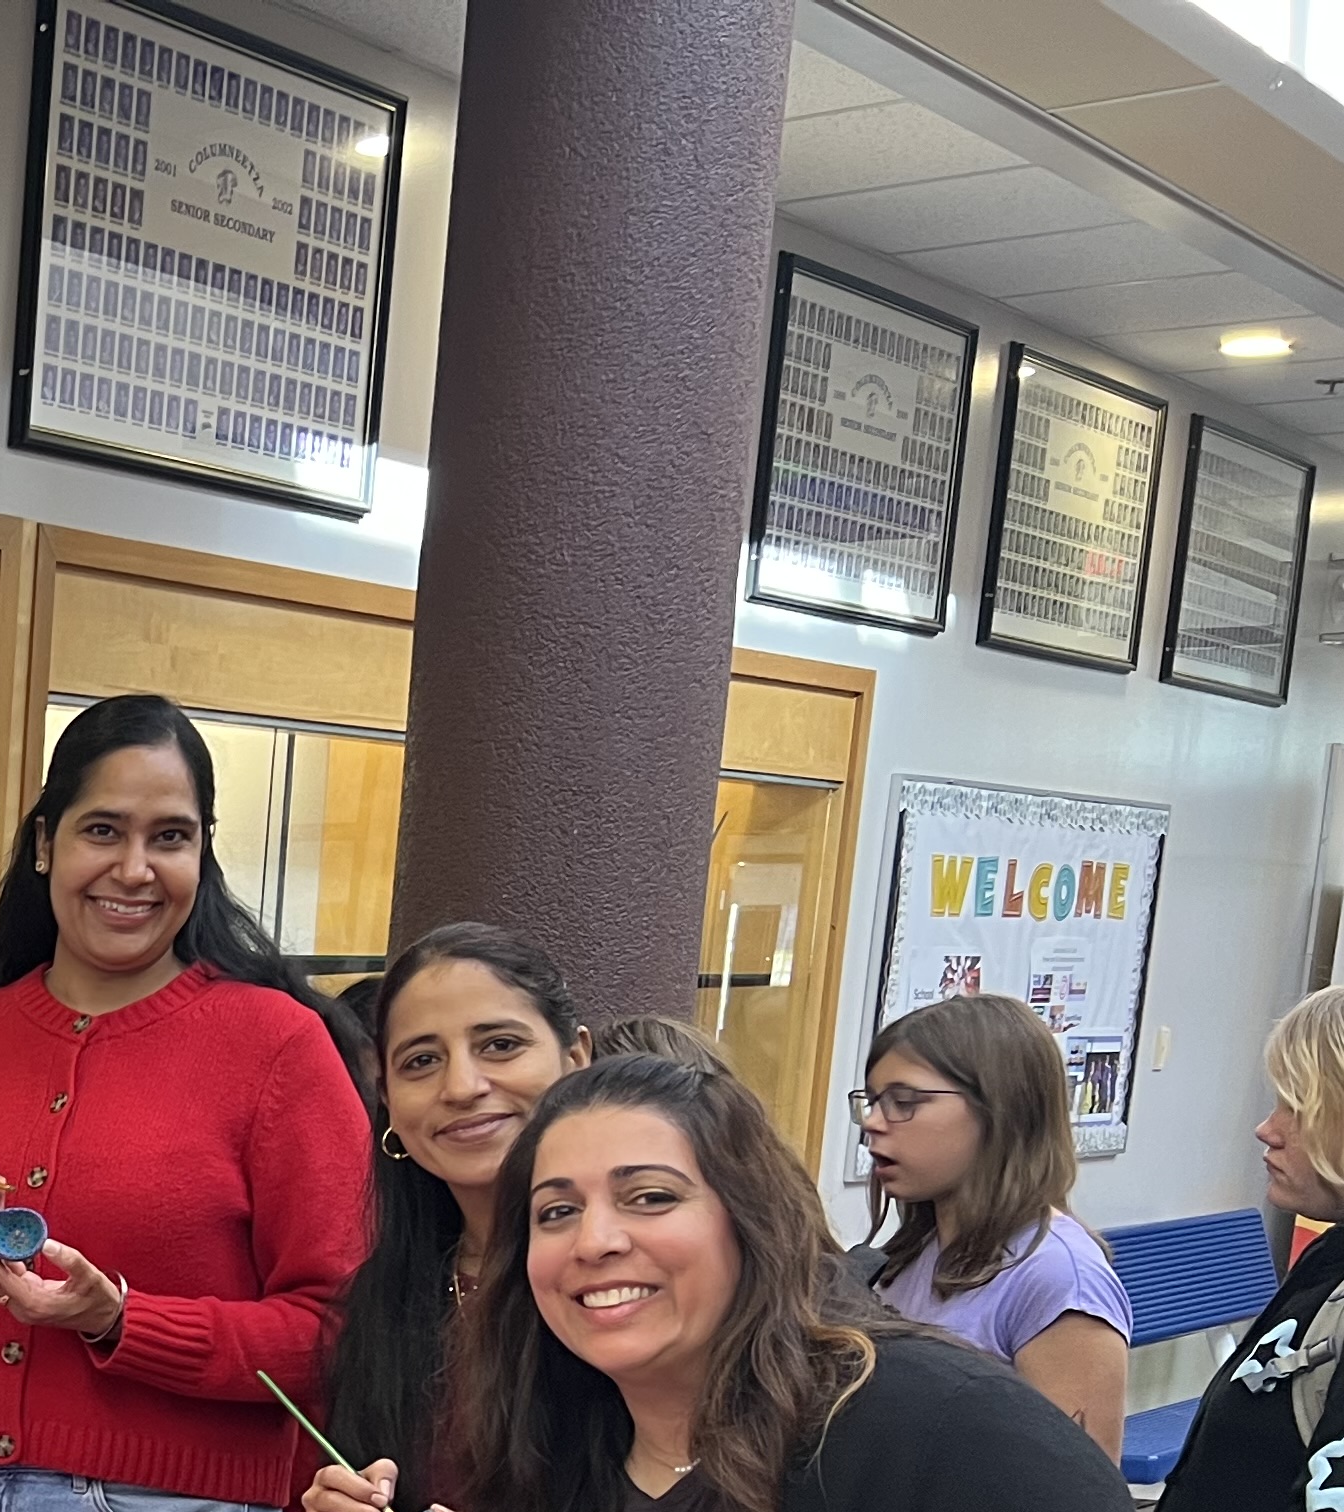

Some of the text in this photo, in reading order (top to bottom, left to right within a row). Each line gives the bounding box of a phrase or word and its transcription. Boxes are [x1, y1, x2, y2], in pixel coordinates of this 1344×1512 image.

[154, 158, 177, 178] 2001
[170, 199, 276, 243] SENIOR SECONDARY
[929, 853, 1131, 922] WELCOME
